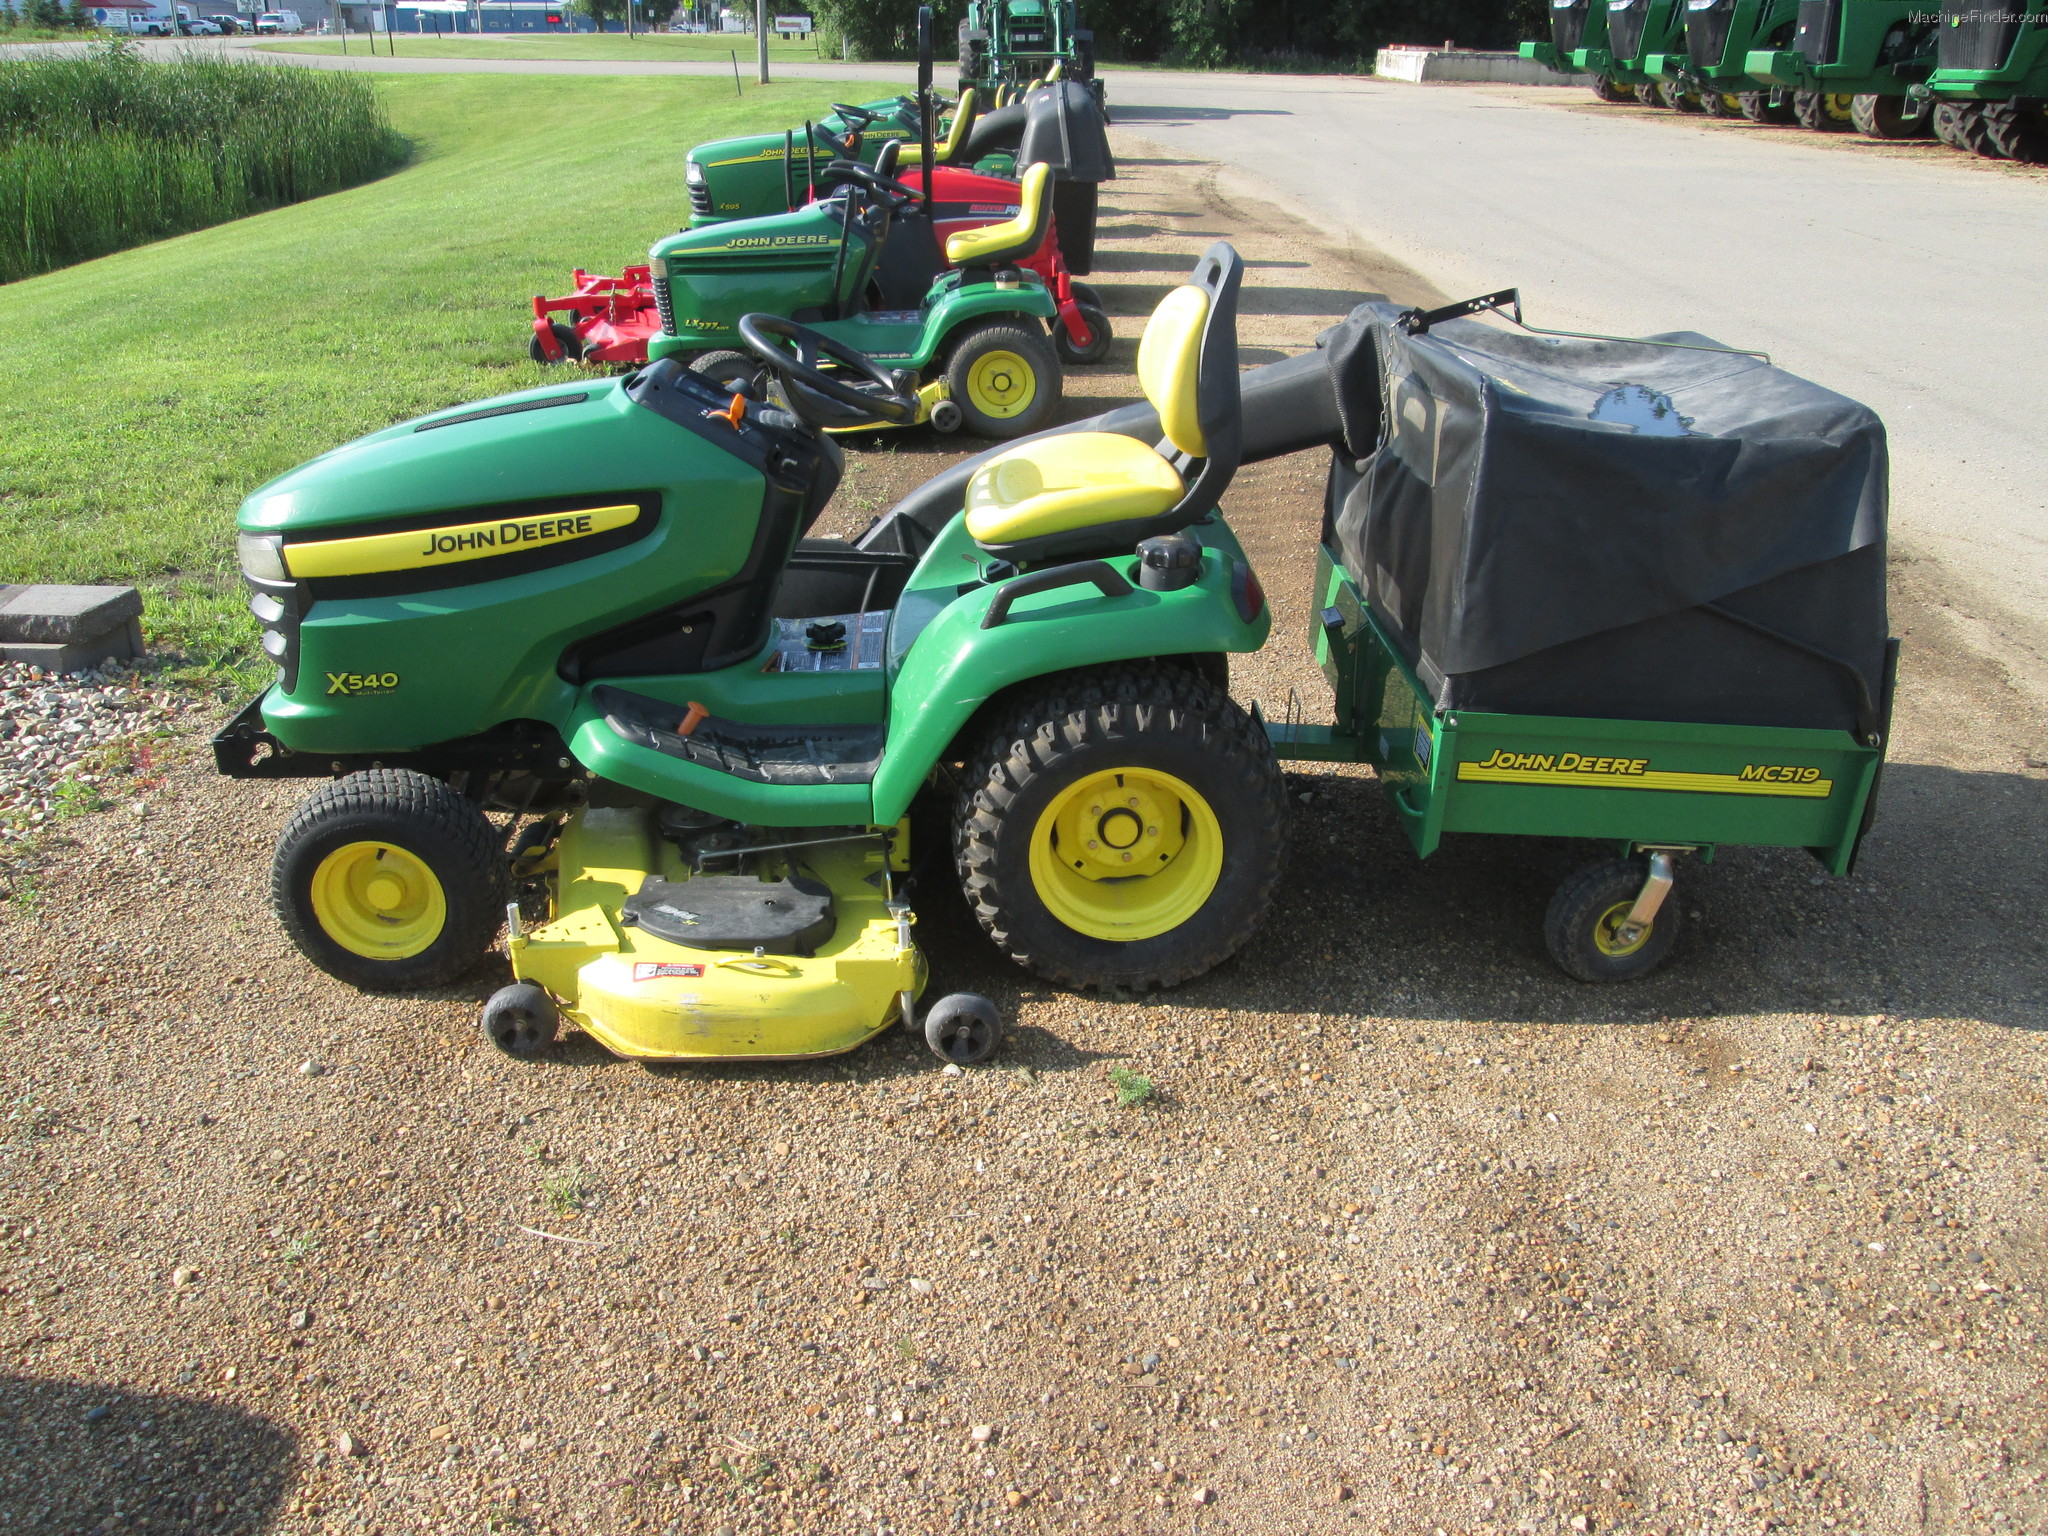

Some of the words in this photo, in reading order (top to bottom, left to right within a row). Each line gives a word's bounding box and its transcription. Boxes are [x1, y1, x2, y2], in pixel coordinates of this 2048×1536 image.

[726, 237, 771, 249] JOHN
[774, 234, 829, 245] DEERE
[423, 529, 496, 556] JOHN
[500, 515, 593, 545] DEERE
[325, 671, 400, 694] X540
[1479, 748, 1555, 771] JOHN
[1556, 752, 1649, 775] DEERE
[1738, 764, 1821, 783] MC519
